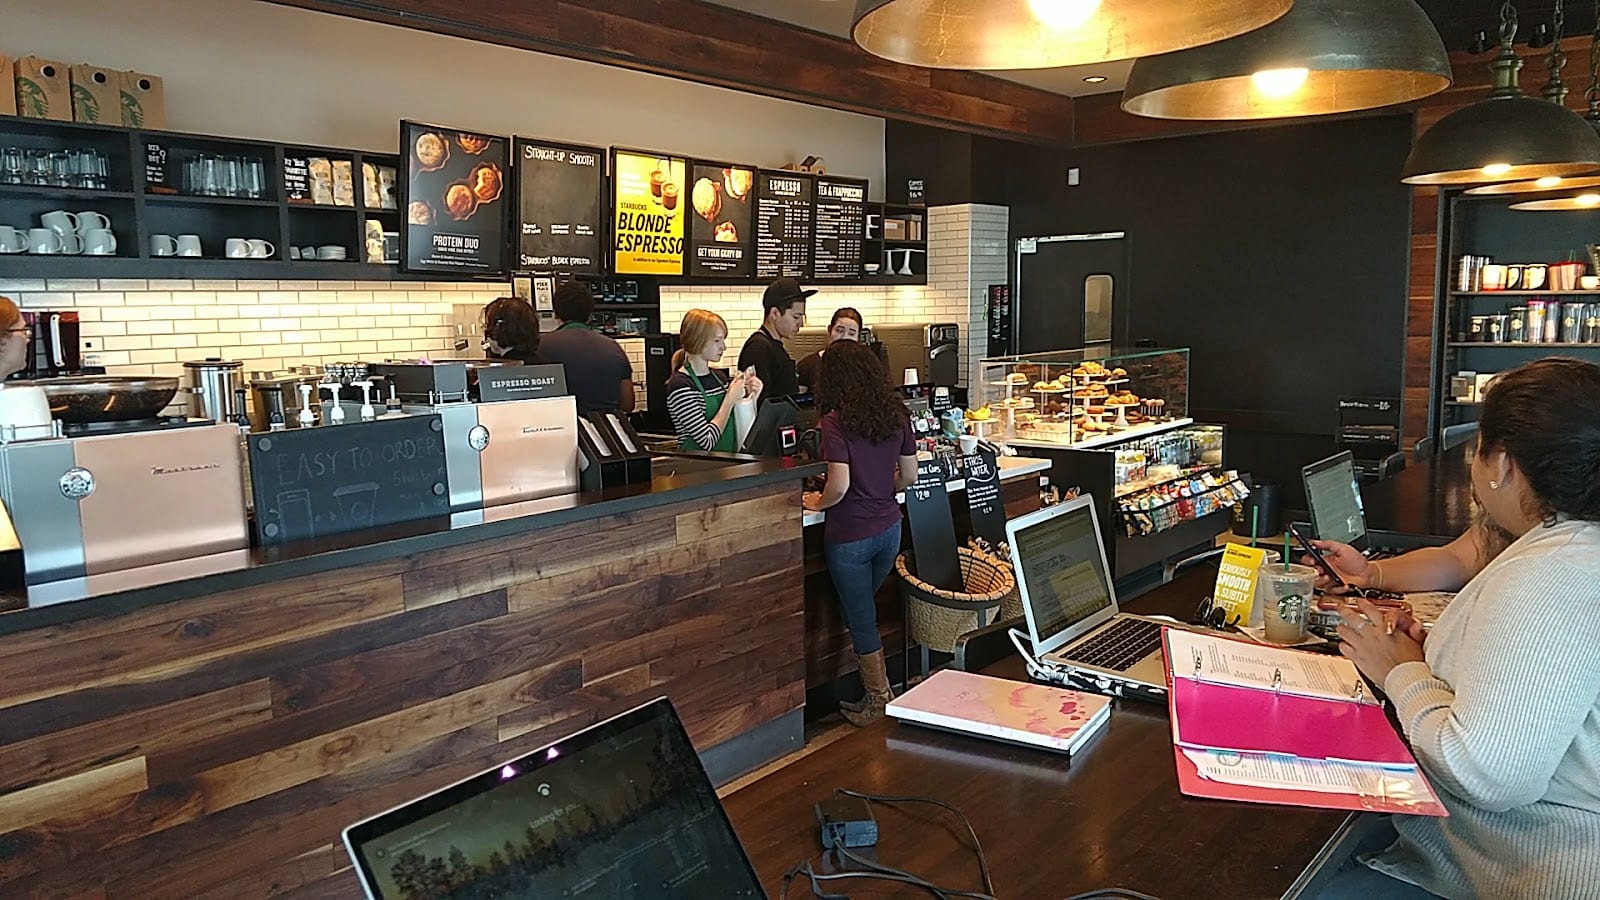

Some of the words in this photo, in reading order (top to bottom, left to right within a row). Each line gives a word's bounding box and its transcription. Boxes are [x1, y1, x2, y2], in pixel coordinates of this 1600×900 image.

[569, 152, 595, 167] SMOOTH
[769, 179, 801, 193] ESPRESSO
[818, 185, 828, 196] TEA
[620, 202, 647, 211] STARBUCKS
[617, 211, 673, 234] BLONDE
[432, 235, 463, 248] PROTEIN
[464, 237, 480, 249] DUO
[615, 232, 685, 255] ESPRESSO
[491, 379, 530, 389] ESPRESSO
[531, 377, 556, 387] ROAST
[277, 450, 338, 486] EASY
[348, 446, 373, 471] TO
[963, 455, 983, 469] ETHOS
[970, 463, 991, 477] WATER
[1216, 572, 1252, 592] SMOOTH
[1220, 588, 1250, 603] SUBTLY
